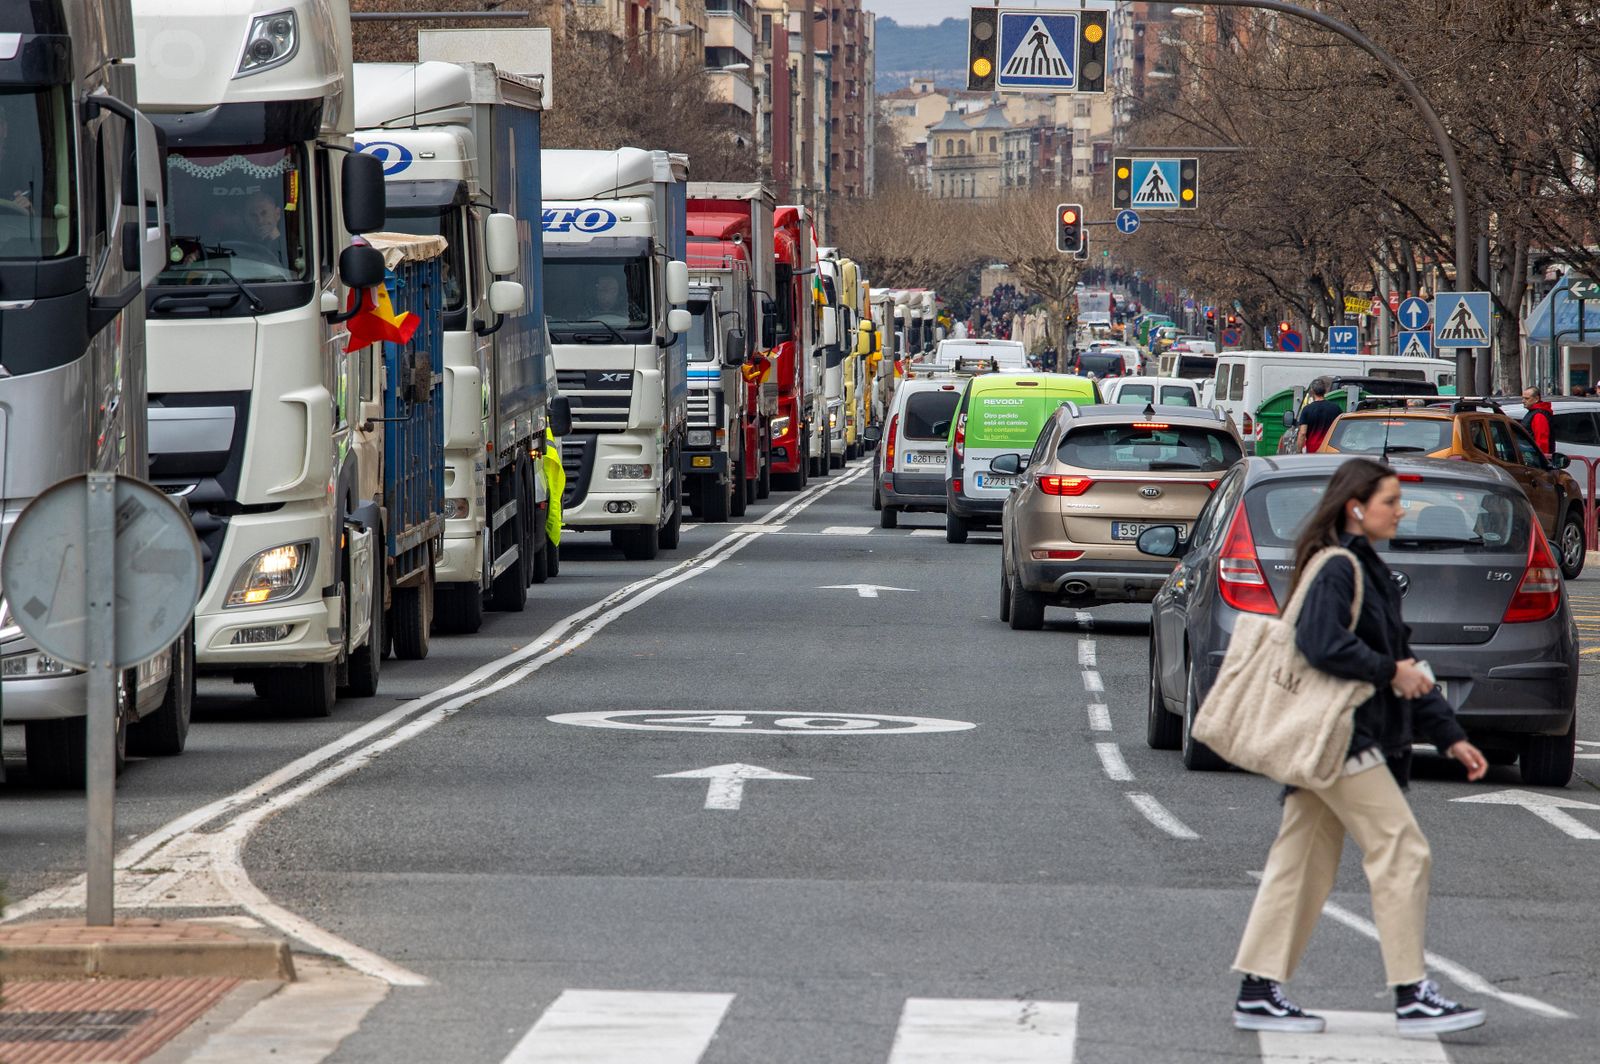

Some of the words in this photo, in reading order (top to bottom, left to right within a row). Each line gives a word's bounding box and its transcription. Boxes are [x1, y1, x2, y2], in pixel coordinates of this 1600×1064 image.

[213, 185, 260, 196] DAF
[542, 208, 617, 232] TO
[1334, 332, 1353, 343] VP
[599, 373, 630, 381] XF
[912, 455, 931, 464] 8261
[983, 477, 1006, 486] 2778
[644, 714, 880, 730] 40
